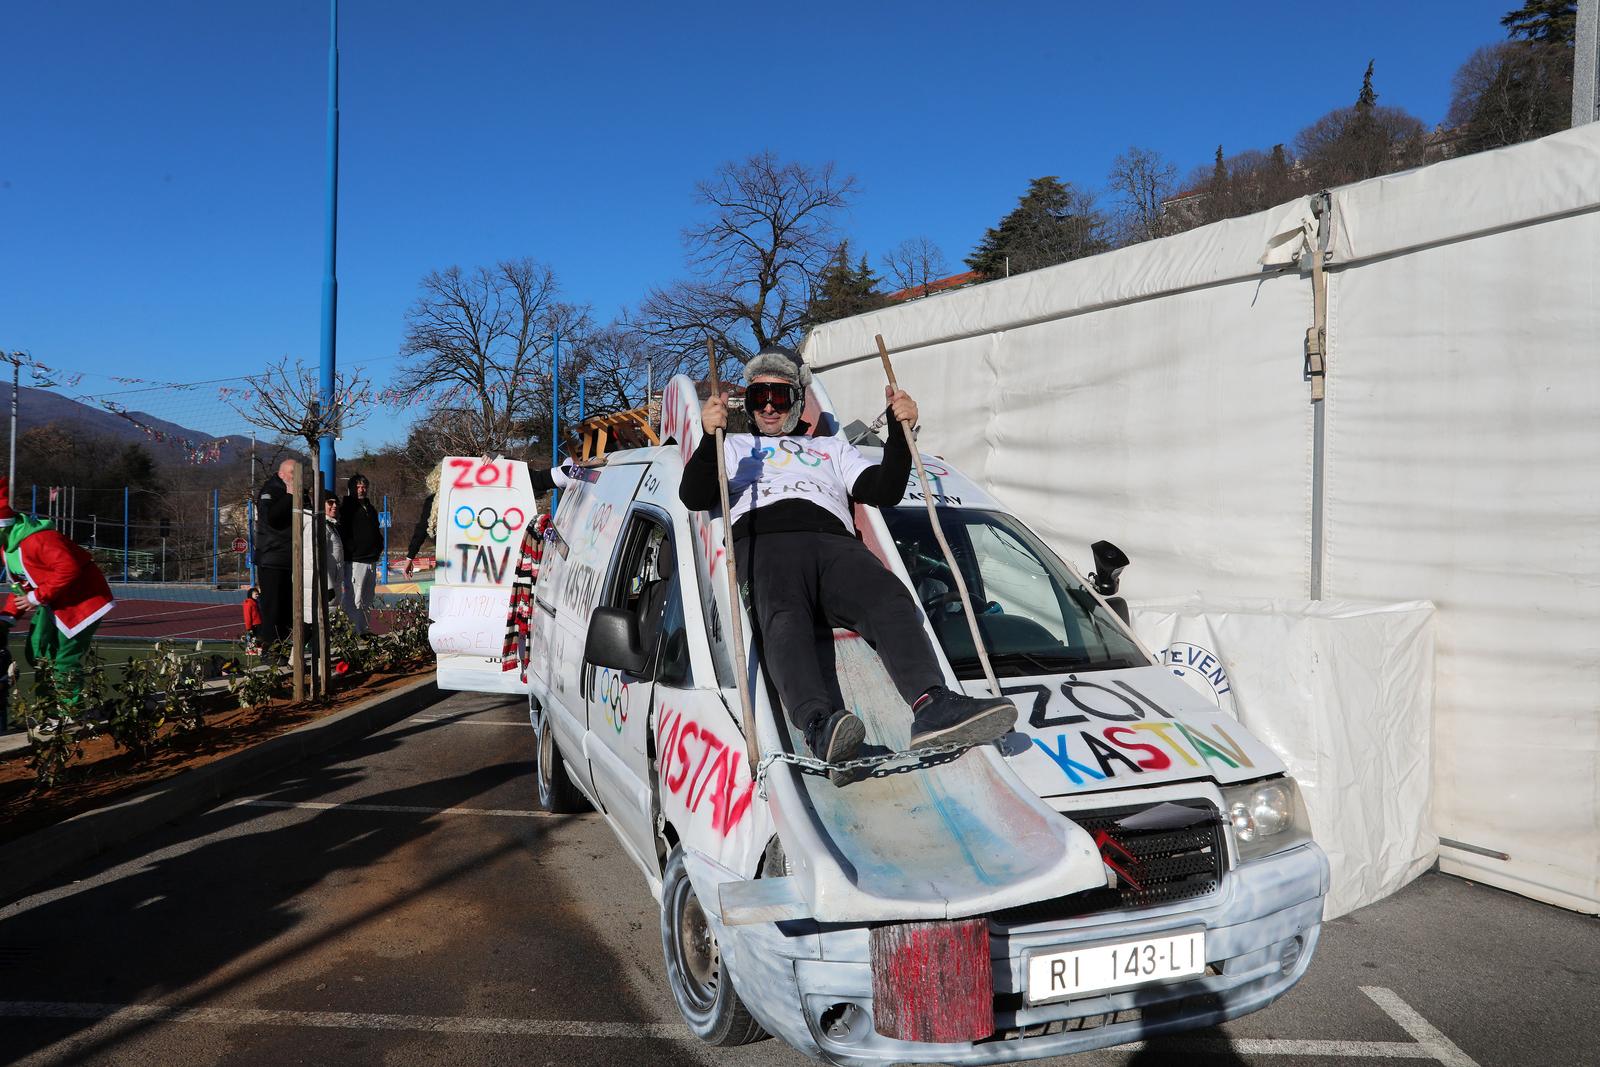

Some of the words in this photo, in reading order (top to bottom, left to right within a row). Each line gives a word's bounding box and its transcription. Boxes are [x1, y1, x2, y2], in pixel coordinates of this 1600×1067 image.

[450, 459, 513, 489] ZOI
[455, 543, 511, 585] TAV
[986, 680, 1175, 728] ZOI
[657, 702, 756, 838] KASTAV
[1032, 722, 1255, 785] KASTAV
[1050, 957, 1079, 991] RI
[1111, 938, 1194, 981] 143-LI
